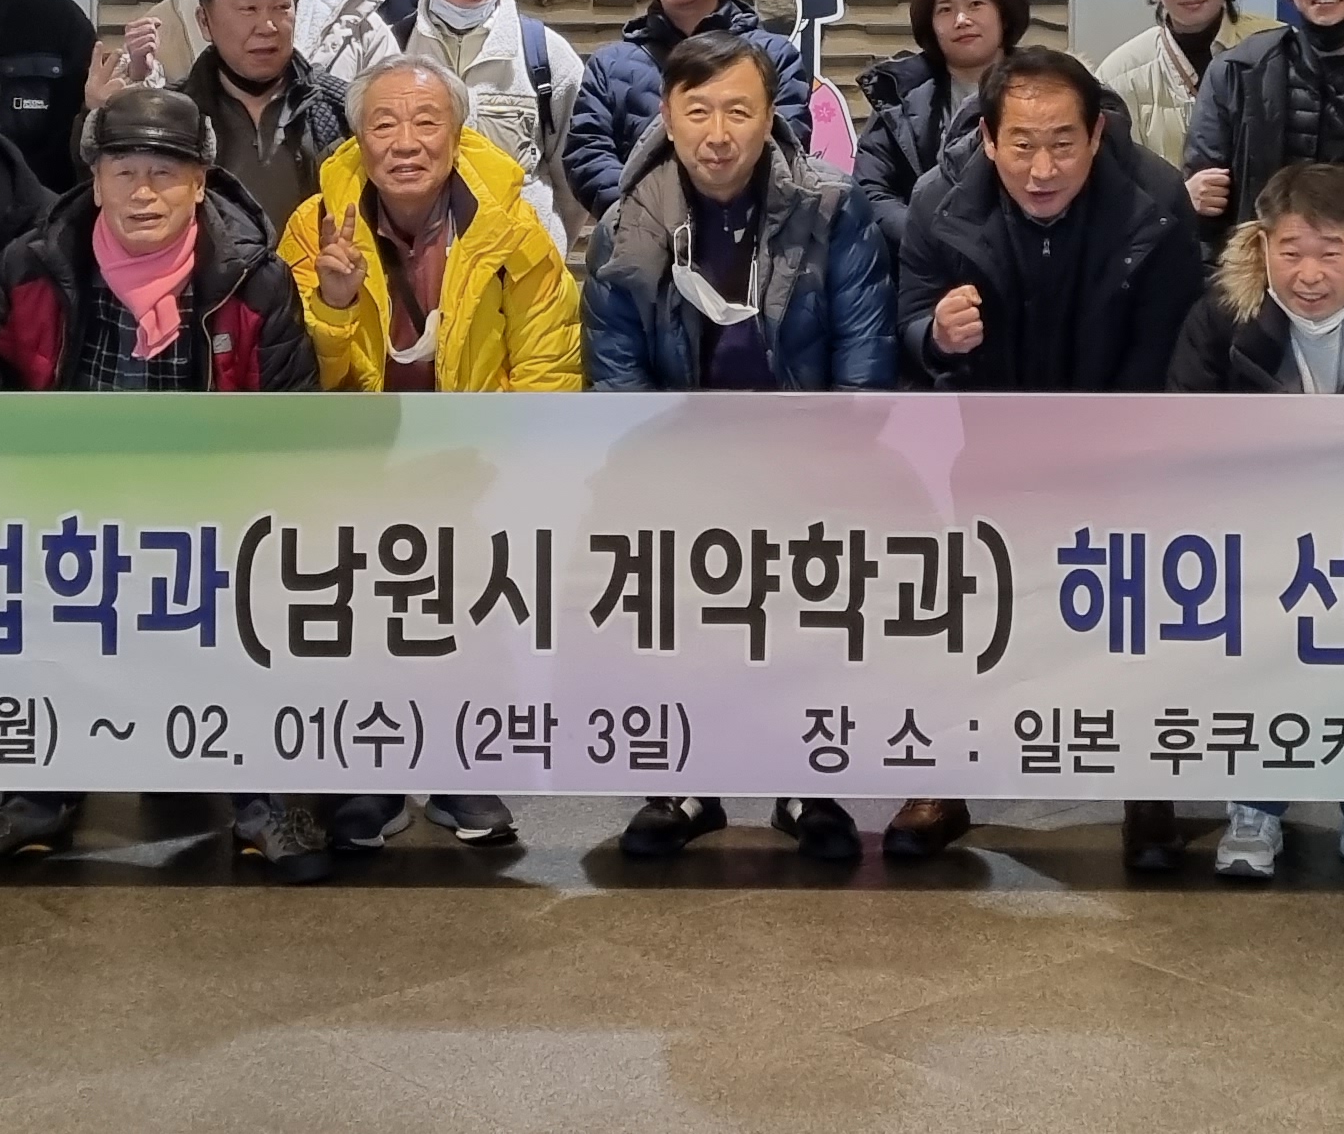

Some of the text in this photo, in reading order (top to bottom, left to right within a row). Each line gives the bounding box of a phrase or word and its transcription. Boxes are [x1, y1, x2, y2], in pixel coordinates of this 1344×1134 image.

[588, 519, 1015, 675] 계약학과)
[1057, 526, 1243, 658] 해외
[166, 704, 244, 765] 02.
[274, 699, 424, 769] 01(수)
[455, 700, 559, 770] (2박
[586, 702, 692, 772] 3일)
[1013, 707, 1121, 774] 일본
